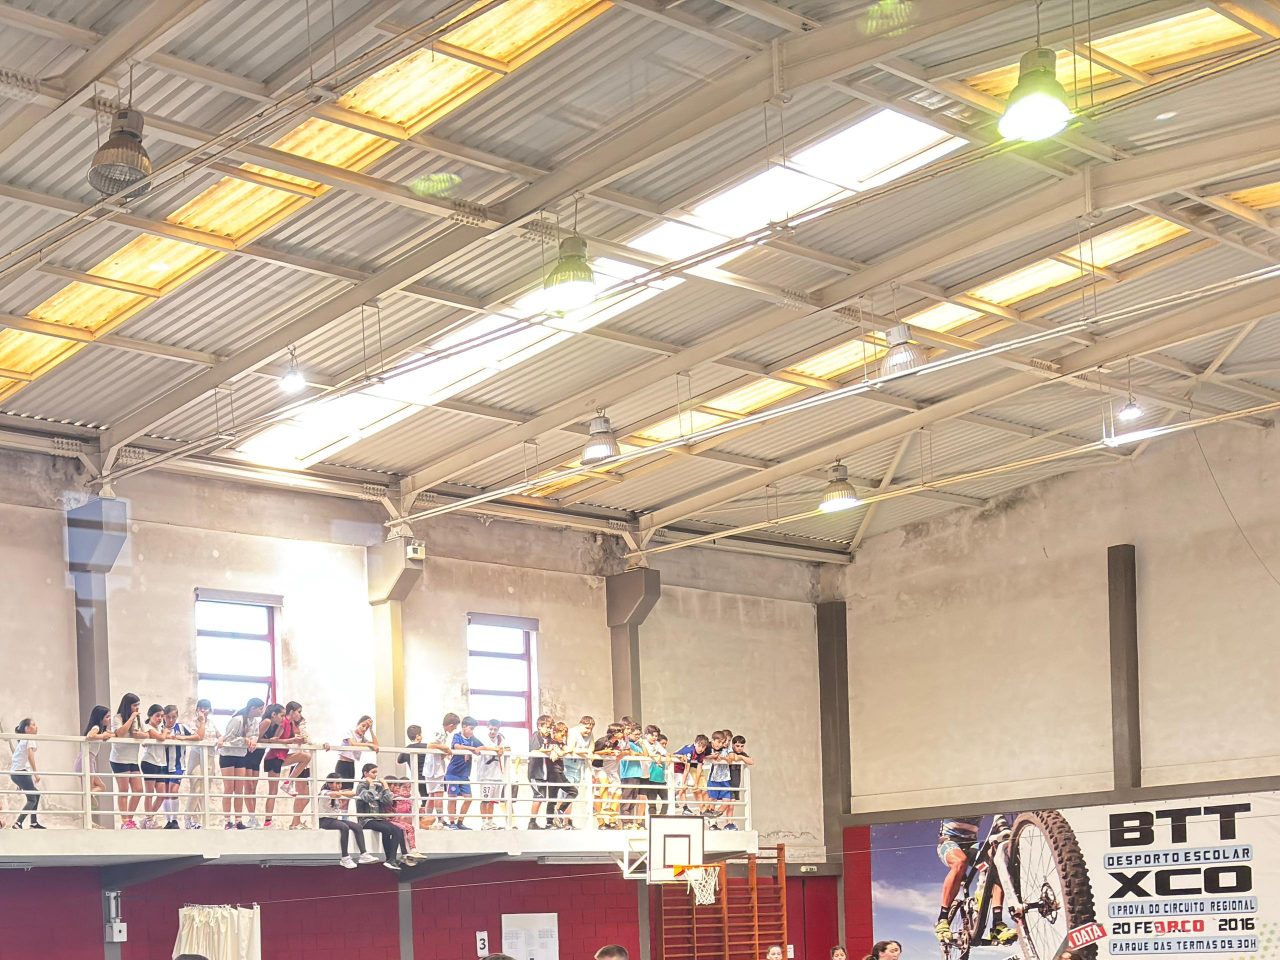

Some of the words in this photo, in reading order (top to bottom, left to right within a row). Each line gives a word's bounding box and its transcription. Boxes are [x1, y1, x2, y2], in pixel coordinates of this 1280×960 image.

[1109, 803, 1252, 847] BTT
[1107, 852, 1180, 867] DESPORTO
[1184, 848, 1250, 862] ESCOLAR
[1108, 865, 1253, 898] XCO
[1117, 904, 1145, 915] PROVA
[1148, 903, 1160, 914] DO
[1163, 901, 1205, 913] CIRCUITO
[1210, 899, 1255, 911] REGIONAL
[1072, 922, 1103, 946] DATA
[1112, 922, 1131, 935] 20
[1218, 917, 1256, 931] 2016
[479, 938, 487, 950] 3
[1112, 941, 1149, 952] PARQUE
[1153, 940, 1172, 951] DAS
[1176, 939, 1218, 950] TERMAS
